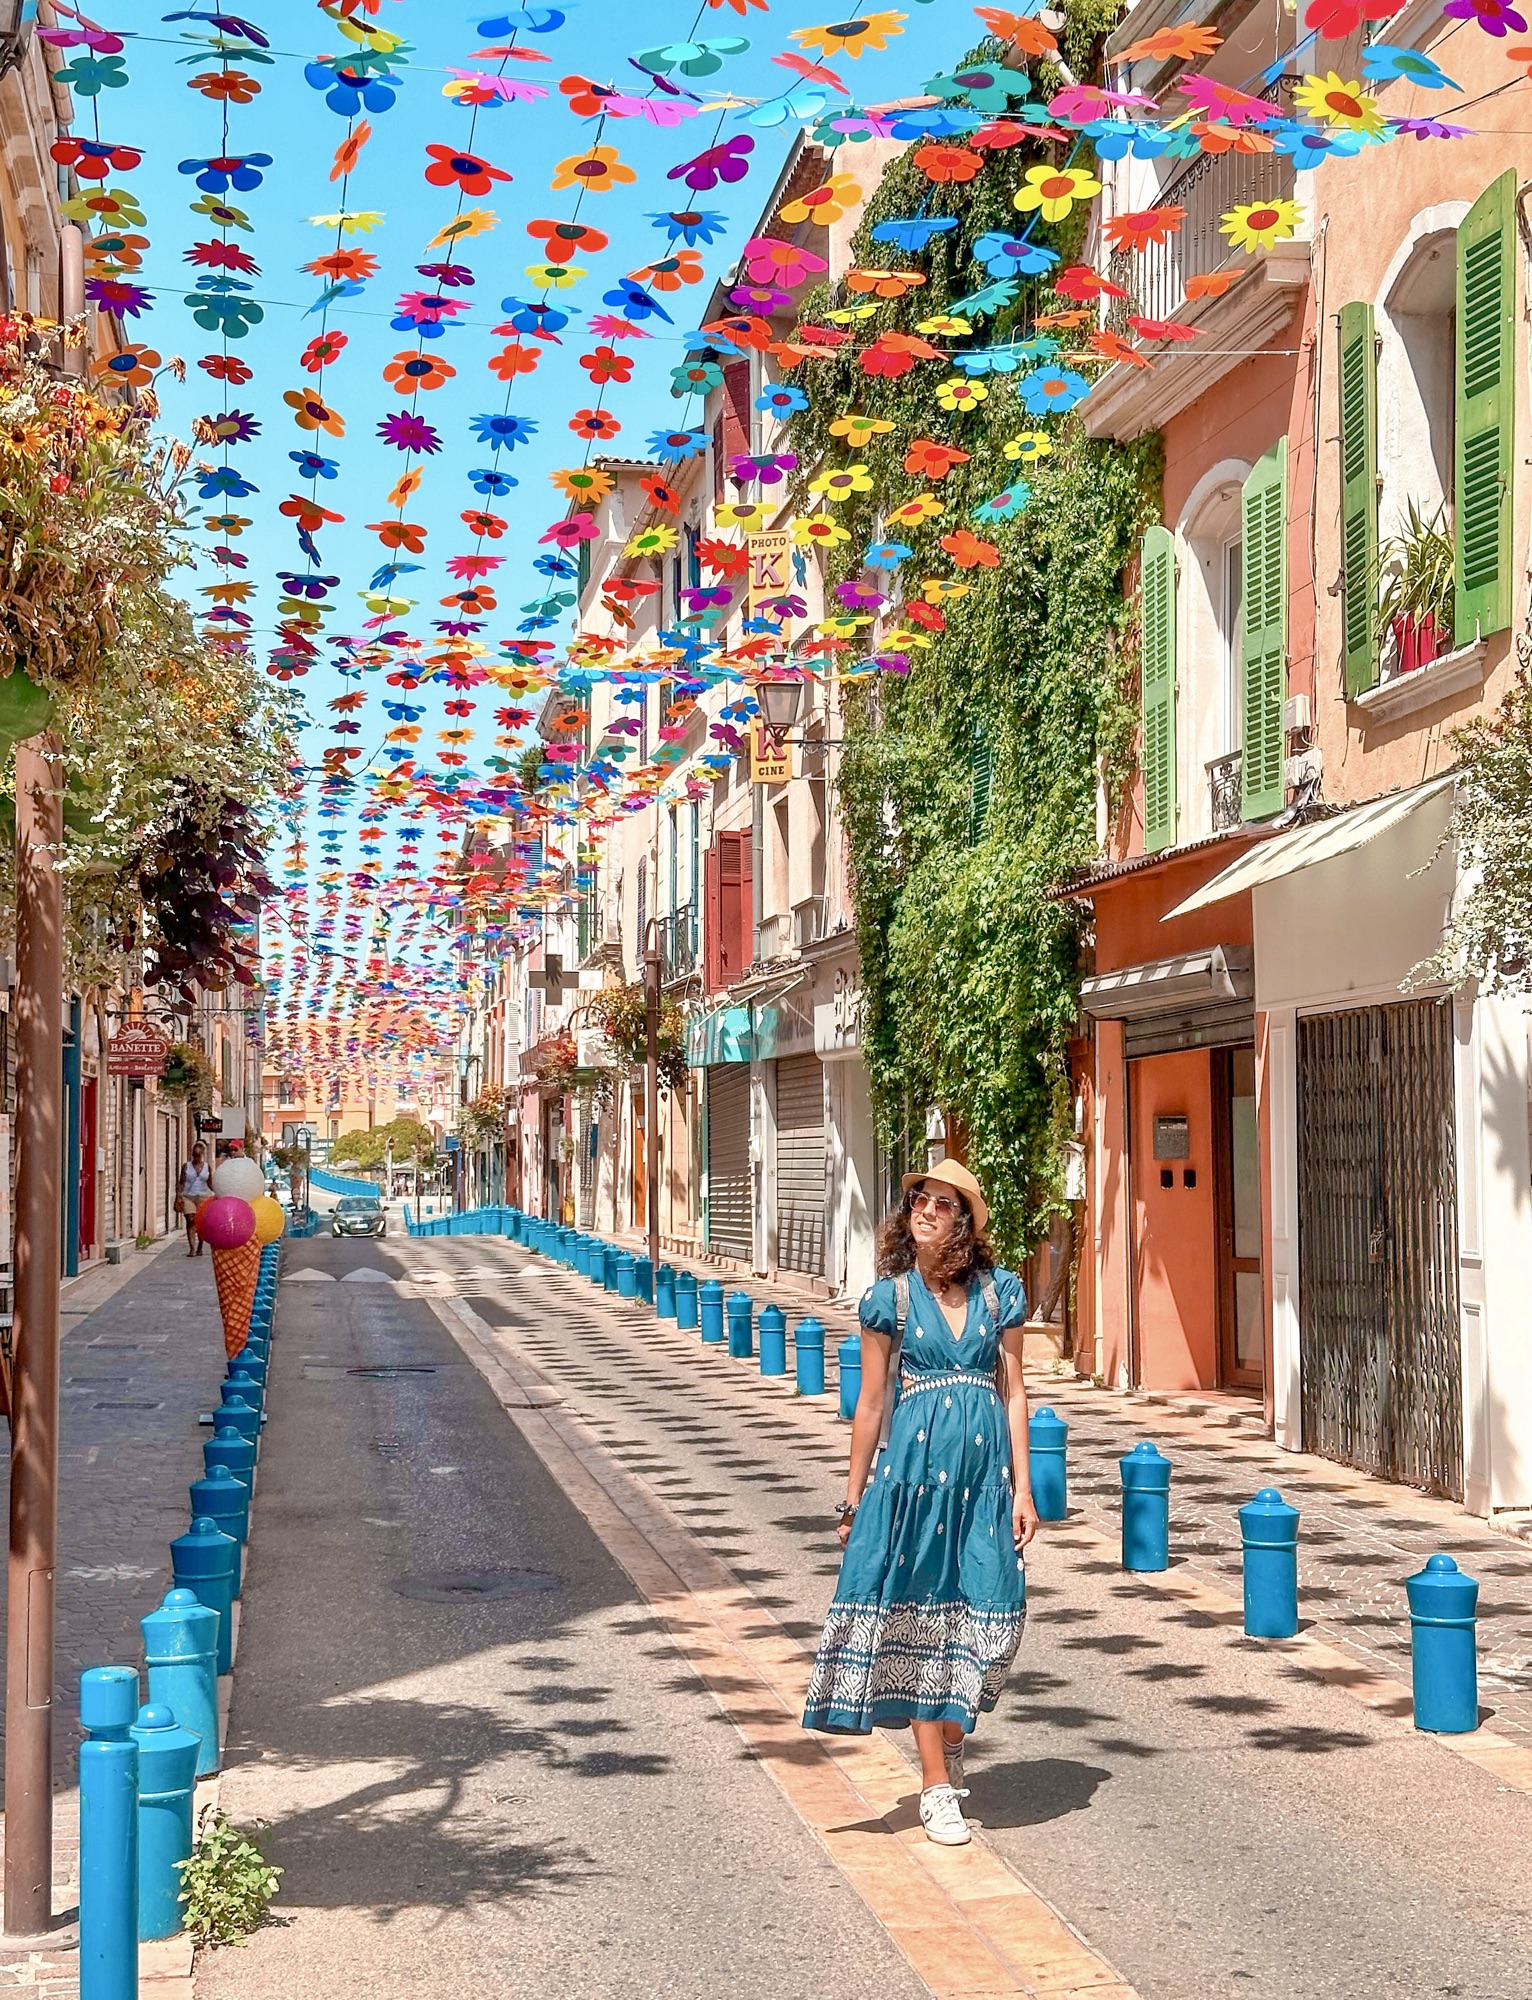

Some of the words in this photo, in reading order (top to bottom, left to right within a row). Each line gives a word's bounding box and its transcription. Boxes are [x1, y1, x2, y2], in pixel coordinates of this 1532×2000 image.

[751, 537, 786, 548] PHOTO
[758, 765, 785, 776] CINE
[110, 1043, 162, 1053] BANETTE
